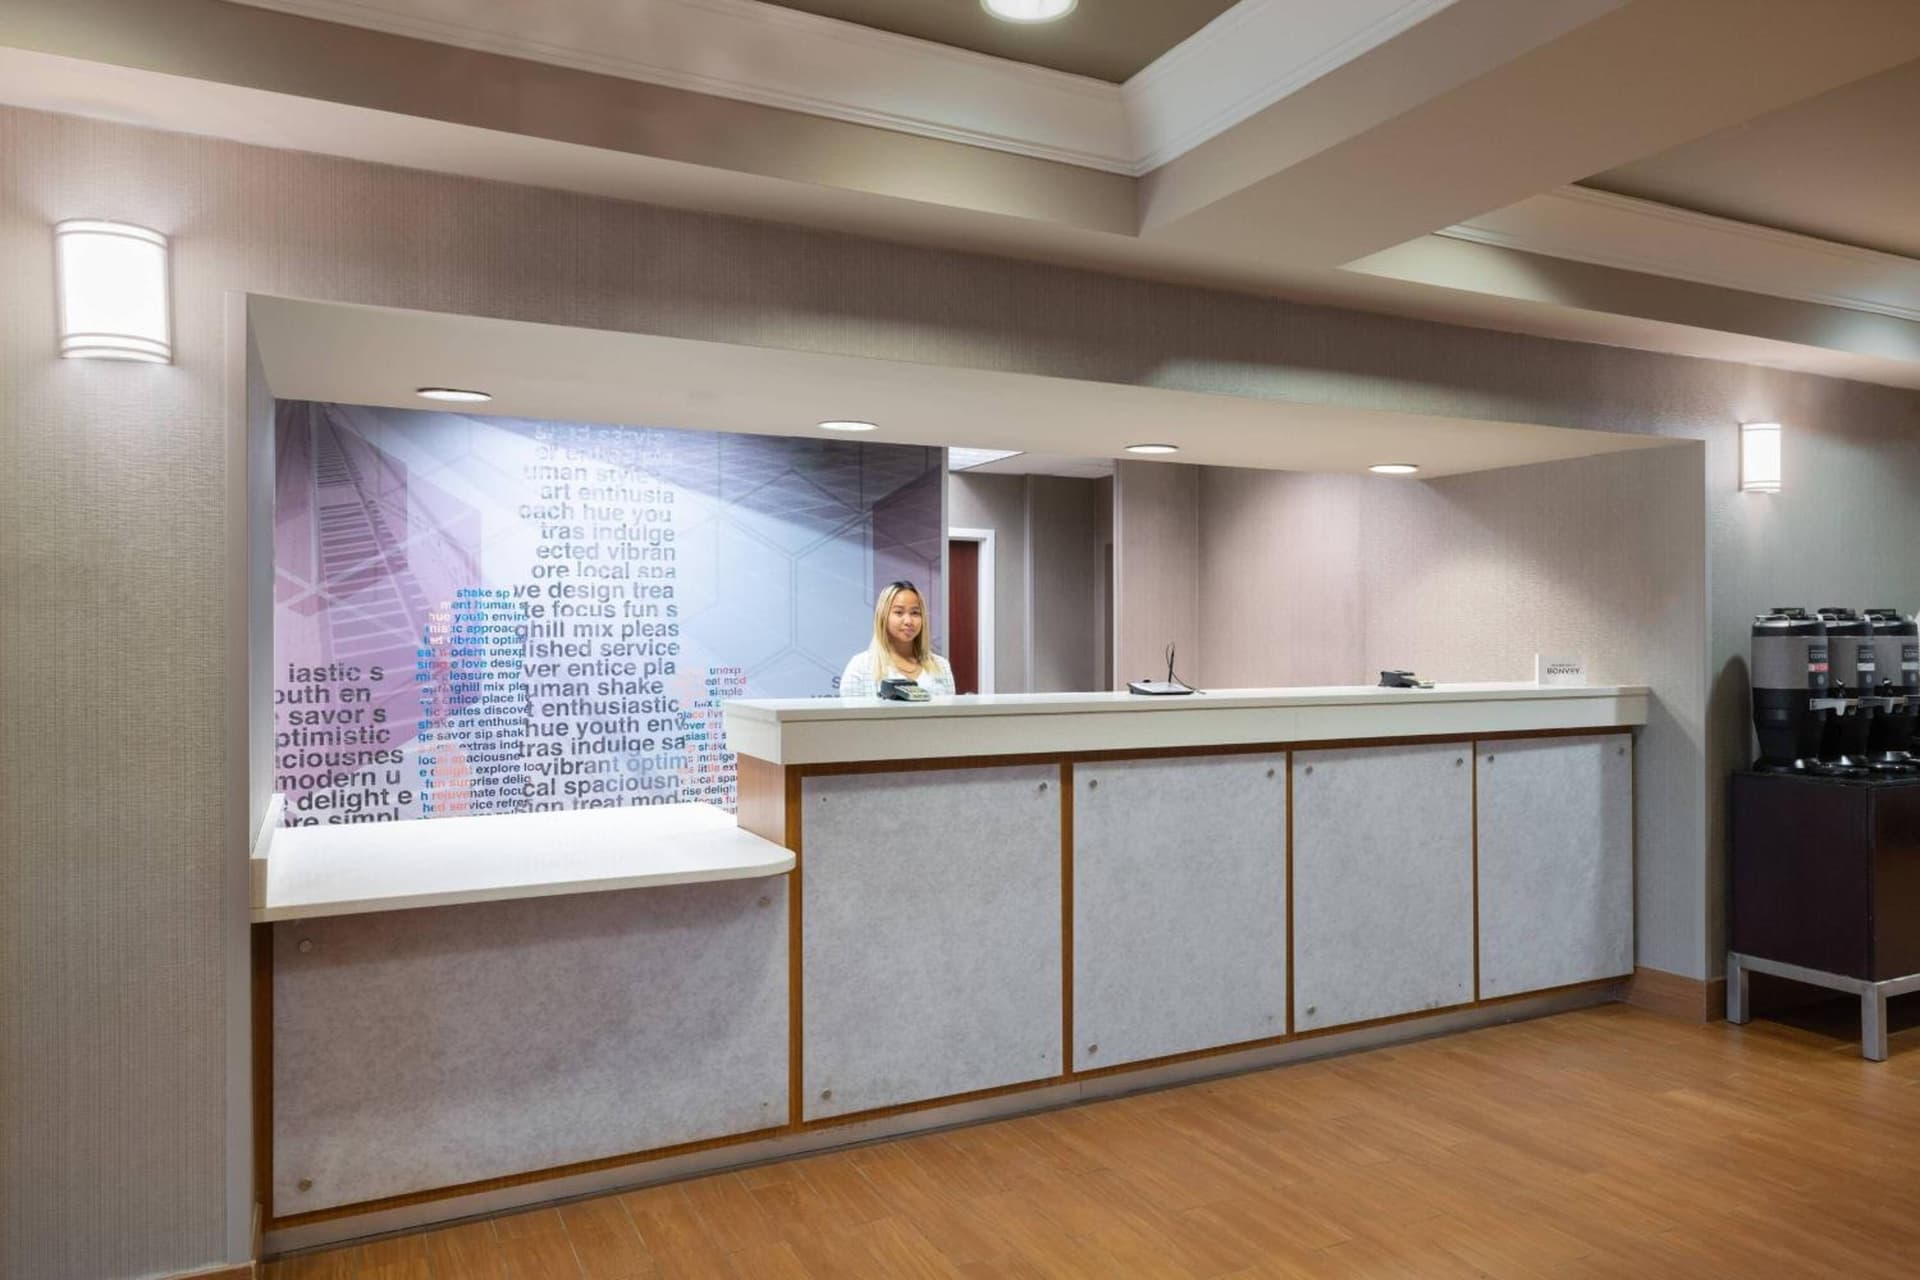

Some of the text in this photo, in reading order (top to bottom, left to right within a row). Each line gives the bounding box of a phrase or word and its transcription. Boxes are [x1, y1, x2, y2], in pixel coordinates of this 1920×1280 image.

[540, 484, 571, 500] art
[583, 503, 624, 520] hue
[593, 523, 675, 546] indulge
[536, 542, 676, 561] ected vibran
[531, 564, 570, 579] ore
[577, 561, 630, 579] local
[548, 581, 625, 603] design
[633, 582, 674, 599] trea
[553, 600, 616, 618] focus
[624, 600, 658, 618] fun
[666, 604, 678, 618] s
[621, 620, 679, 641] pleas
[600, 639, 680, 657] service
[288, 663, 384, 682] iastic s
[567, 658, 636, 678] entice
[644, 658, 676, 680] pla
[339, 687, 371, 703] en
[597, 678, 664, 697] shake
[542, 696, 679, 717] enthusiastic
[288, 707, 386, 726] savor s
[577, 716, 640, 740] youth
[541, 754, 619, 776] vibrant
[386, 770, 401, 785] u
[522, 773, 679, 798] cal spaciousn
[297, 789, 390, 813] delight
[398, 790, 412, 804] e
